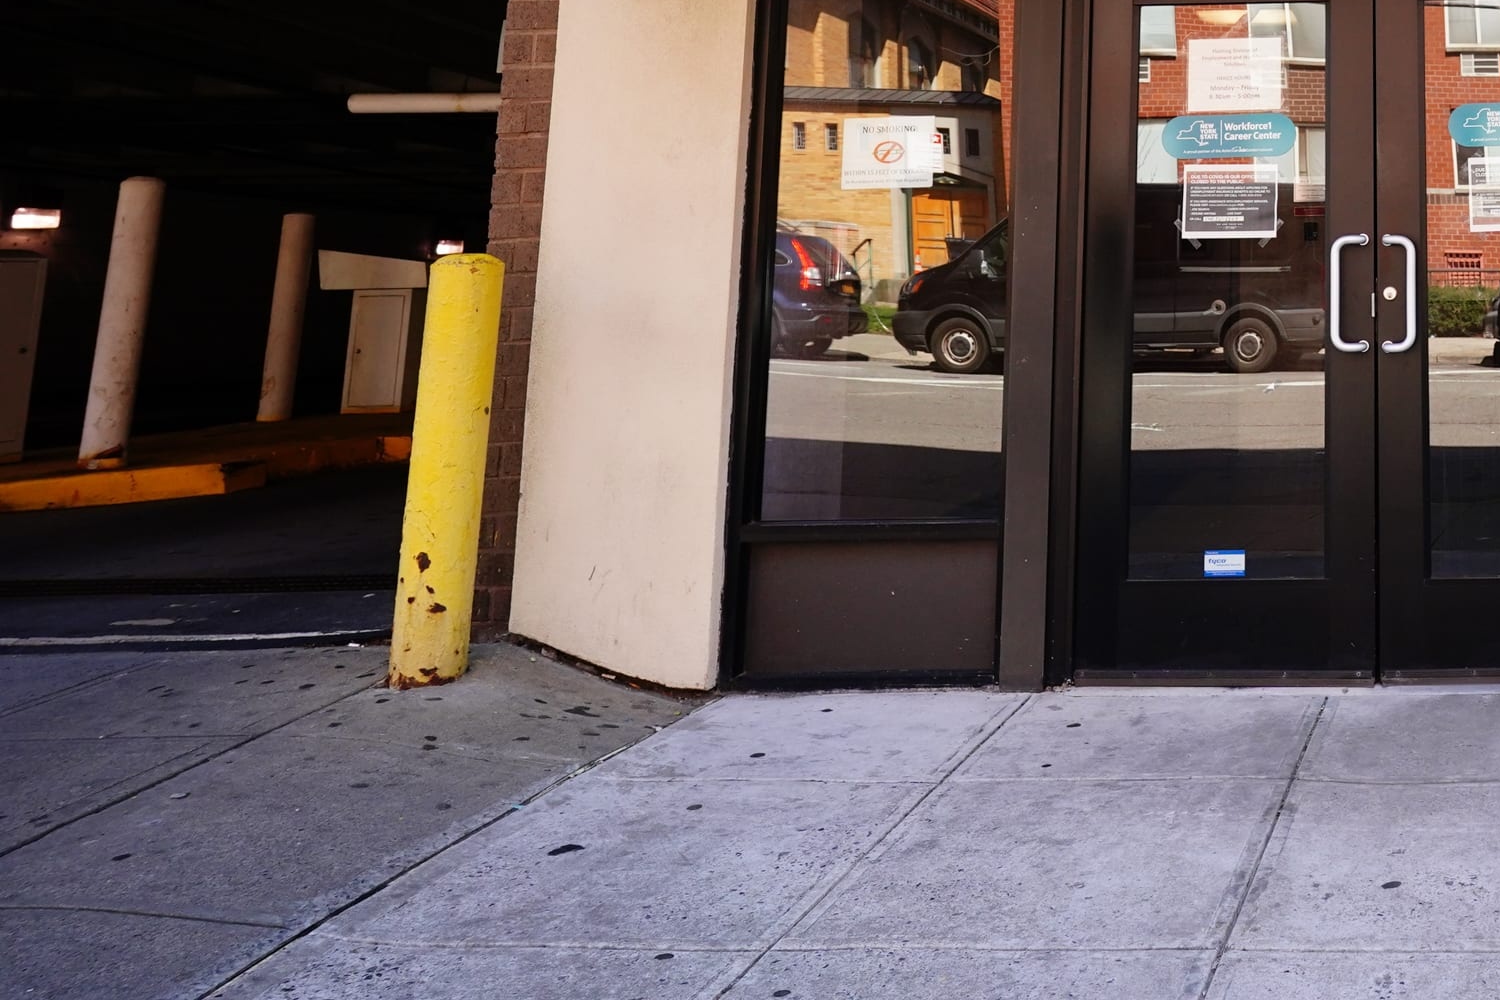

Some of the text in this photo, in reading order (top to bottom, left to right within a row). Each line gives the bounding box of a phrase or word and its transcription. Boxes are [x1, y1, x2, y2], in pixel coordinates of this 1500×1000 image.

[862, 125, 916, 134] NO SMOKING
[1224, 122, 1272, 131] Workforce1
[1224, 131, 1282, 141] Career Center
